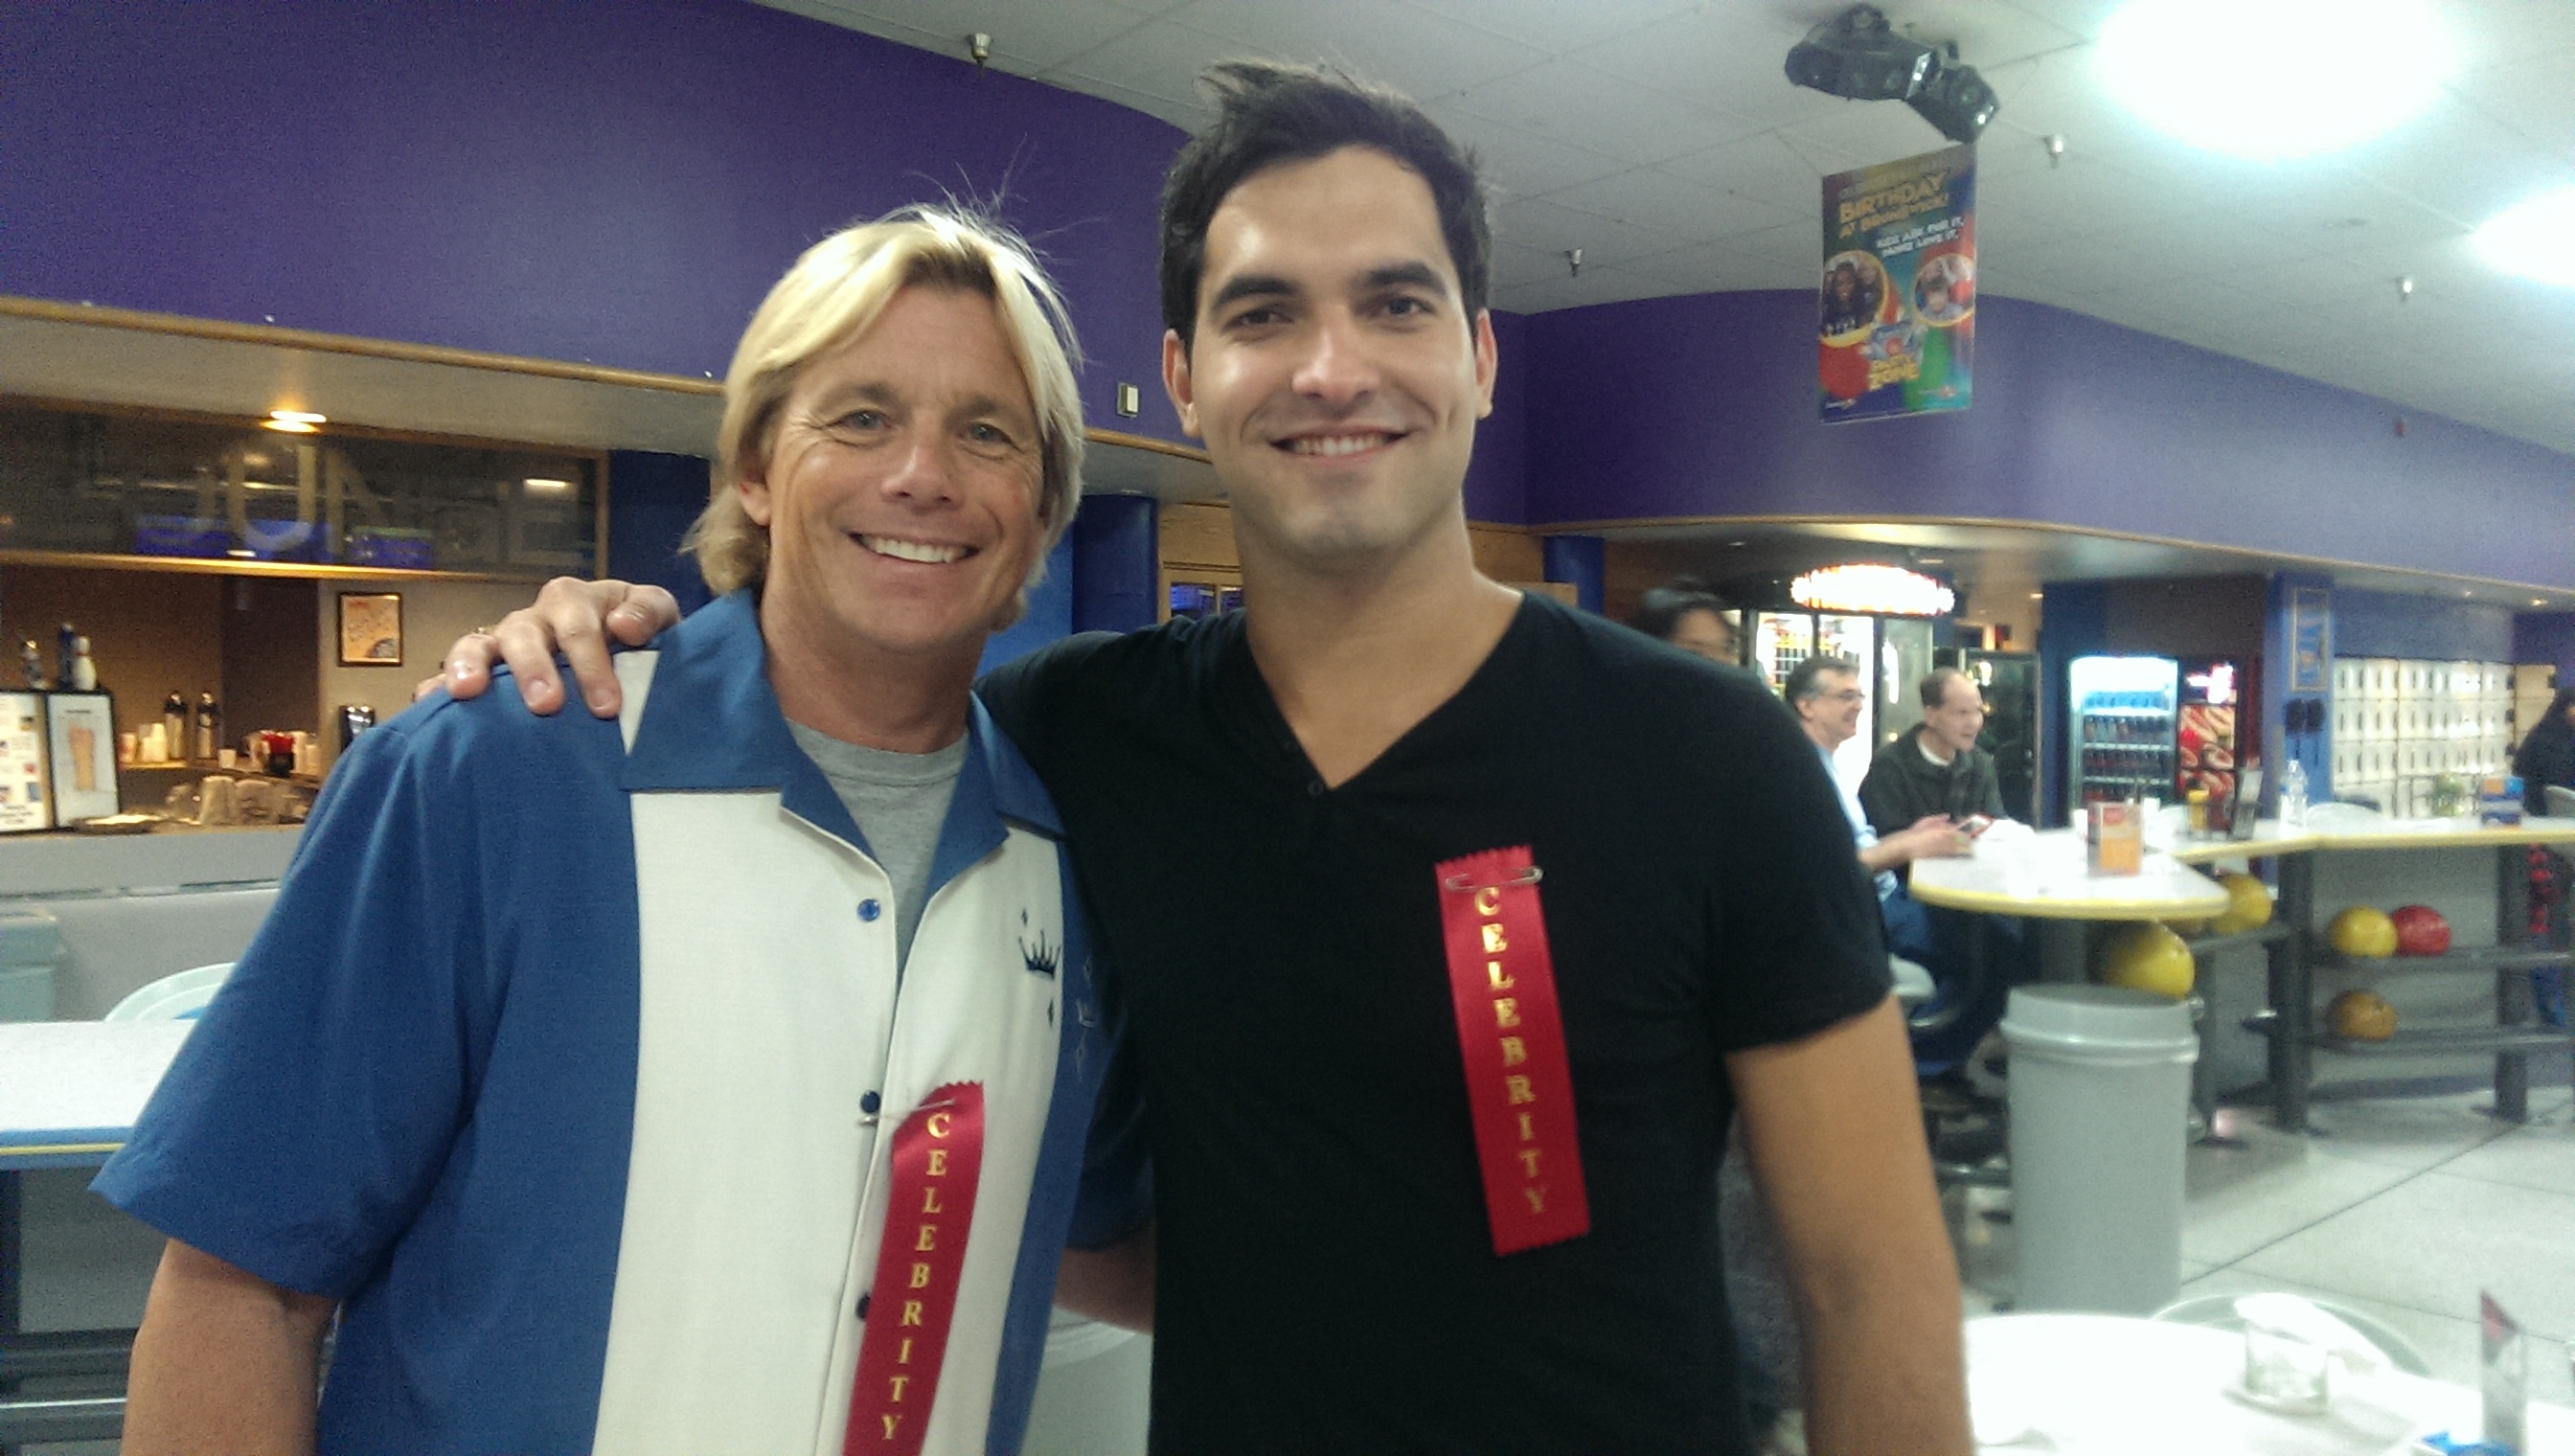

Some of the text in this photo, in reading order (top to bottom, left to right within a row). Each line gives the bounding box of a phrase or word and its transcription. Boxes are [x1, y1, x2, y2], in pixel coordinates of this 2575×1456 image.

[1840, 171, 1948, 223] BIRTHDAY
[1474, 886, 1546, 1214] CELEBRITY
[881, 1113, 950, 1440] CELEBRITY
